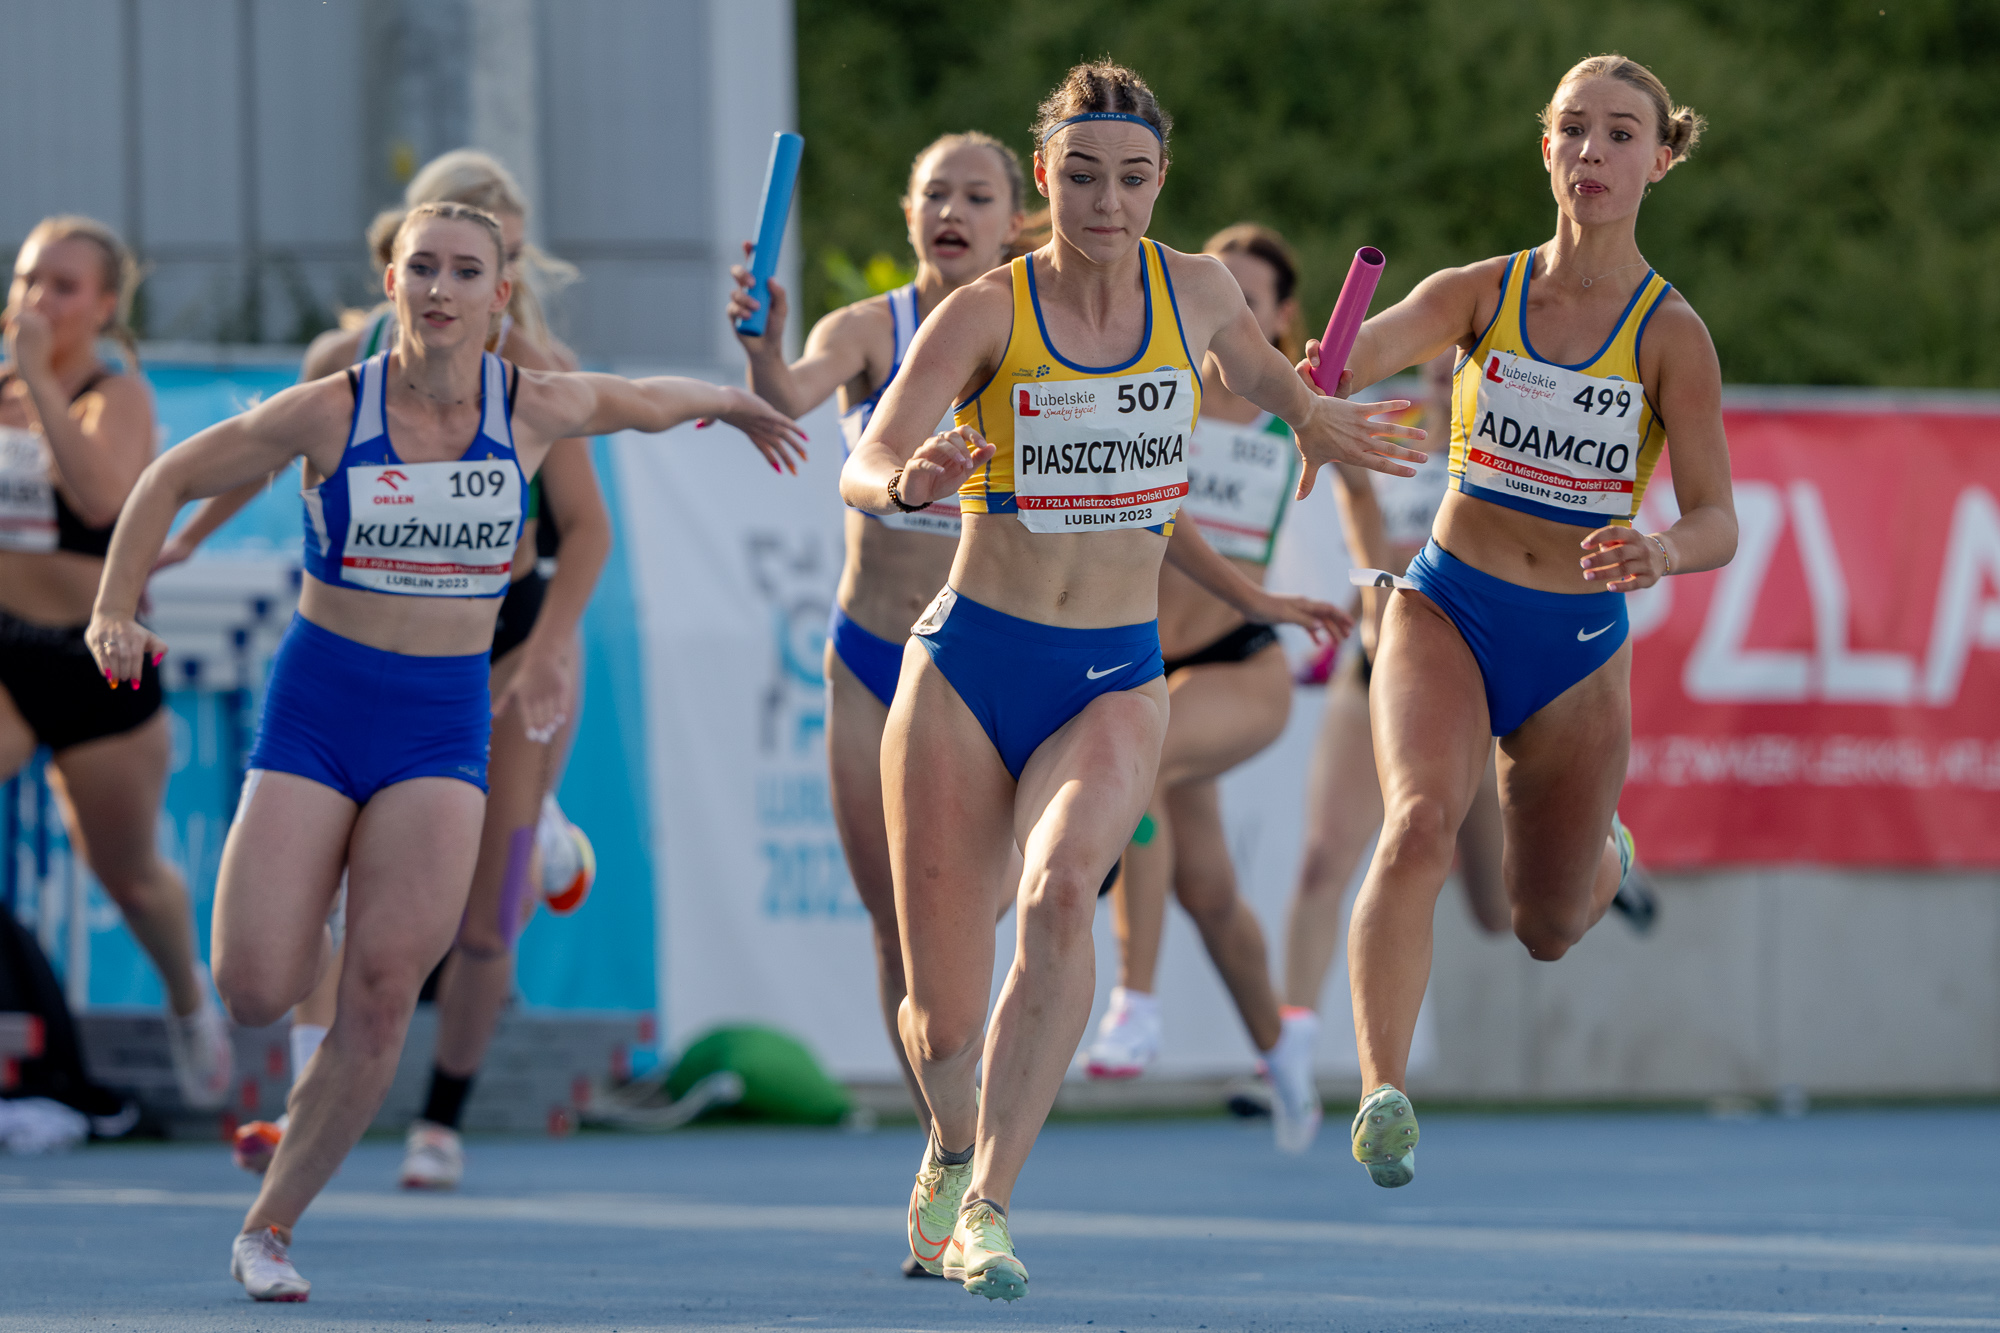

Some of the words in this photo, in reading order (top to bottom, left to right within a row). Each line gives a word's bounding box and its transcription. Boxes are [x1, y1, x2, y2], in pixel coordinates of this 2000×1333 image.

[1117, 380, 1178, 414] 507
[1573, 385, 1631, 418] 499
[1044, 406, 1073, 421] Smakuj
[1074, 405, 1097, 419] życie!
[1022, 432, 1183, 475] PIASZCZYŃSKA
[1477, 410, 1629, 474] ADAMCIO
[449, 470, 505, 498] 109
[1479, 453, 1492, 466] 77.
[1492, 458, 1514, 473] PZLA
[1514, 466, 1573, 487] Mistrzostwa
[1575, 480, 1602, 491] Polski
[1603, 481, 1622, 491] U20
[373, 495, 415, 505] ORLEN
[1029, 498, 1044, 508] 77.
[1046, 498, 1071, 508] PZLA
[1073, 496, 1135, 507] Mistrzostwa
[1136, 489, 1163, 503] Polski
[1164, 487, 1181, 499] U20
[1505, 478, 1550, 498] LUBLIN
[1553, 490, 1587, 505] 2023
[1065, 513, 1116, 525] LUBLIN
[1119, 508, 1153, 523] 2023
[354, 517, 514, 550] KUŹNIARZ
[386, 575, 434, 588] LUBLIN
[437, 577, 469, 589] 2023
